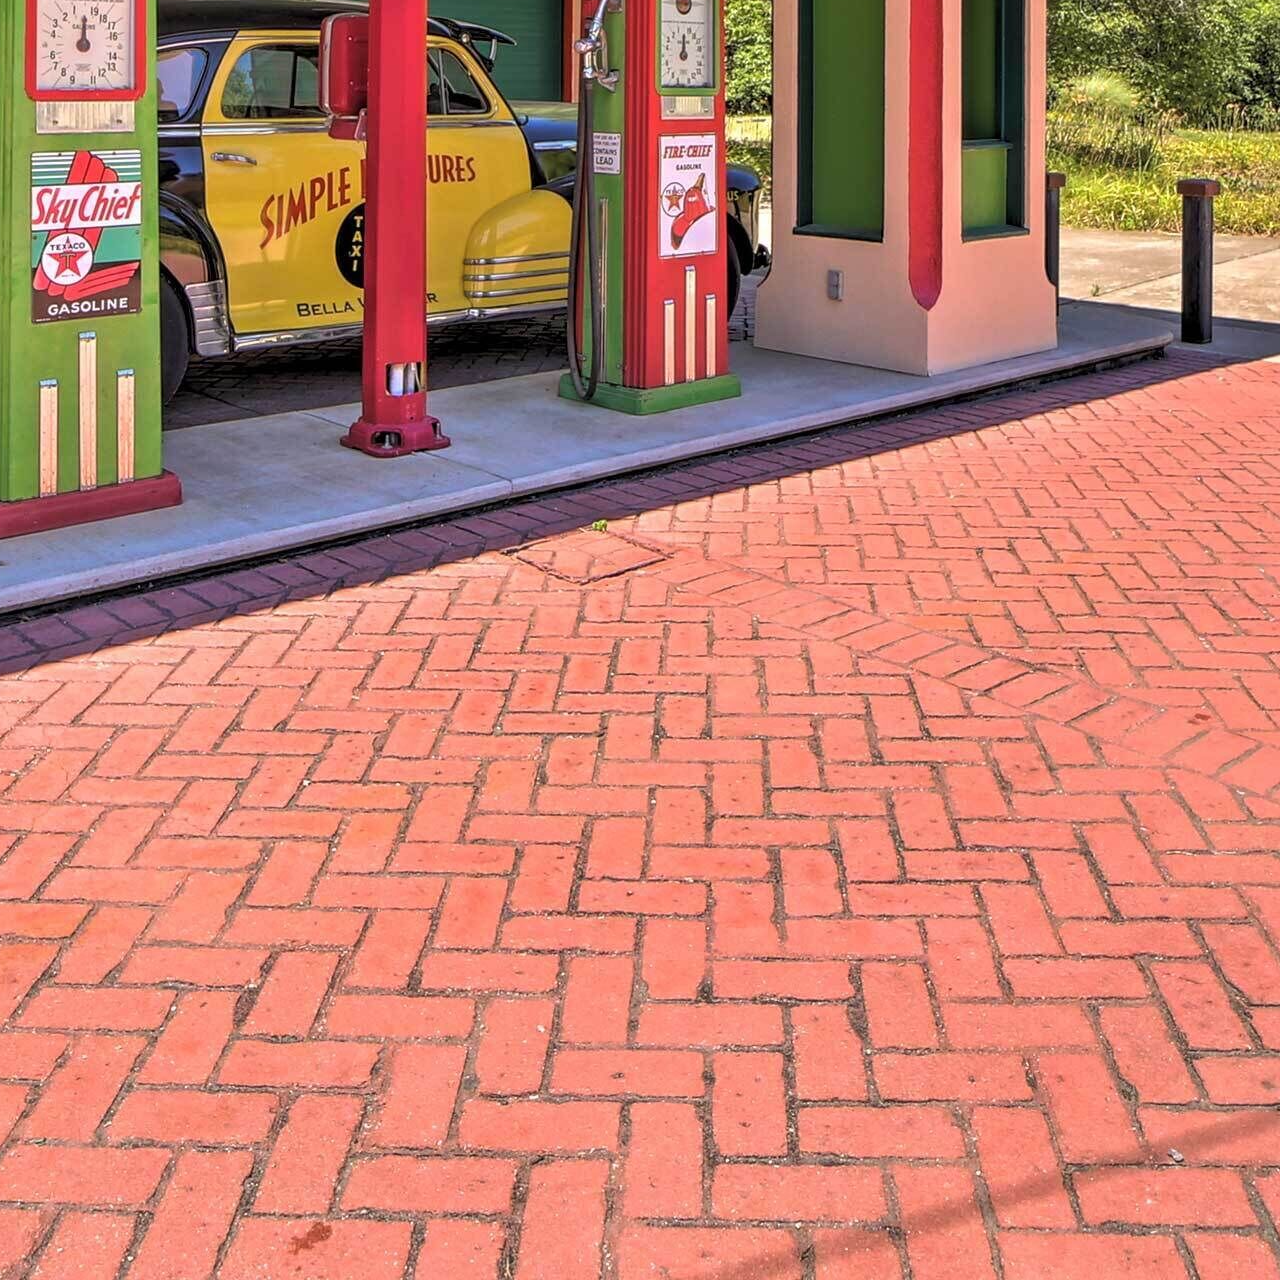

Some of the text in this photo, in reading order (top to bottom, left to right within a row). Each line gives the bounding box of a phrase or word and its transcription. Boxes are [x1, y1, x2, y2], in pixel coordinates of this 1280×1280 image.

[663, 144, 713, 159] FIRE-CHIEF
[596, 156, 614, 166] LEAD
[675, 163, 702, 171] GASOLINE
[33, 183, 142, 229] Sky Chief
[260, 166, 351, 250] SIMPLE
[50, 242, 86, 251] TEXACO
[350, 215, 364, 272] TAXI
[47, 297, 129, 317] GASOLINE
[296, 301, 355, 317] BELLA
